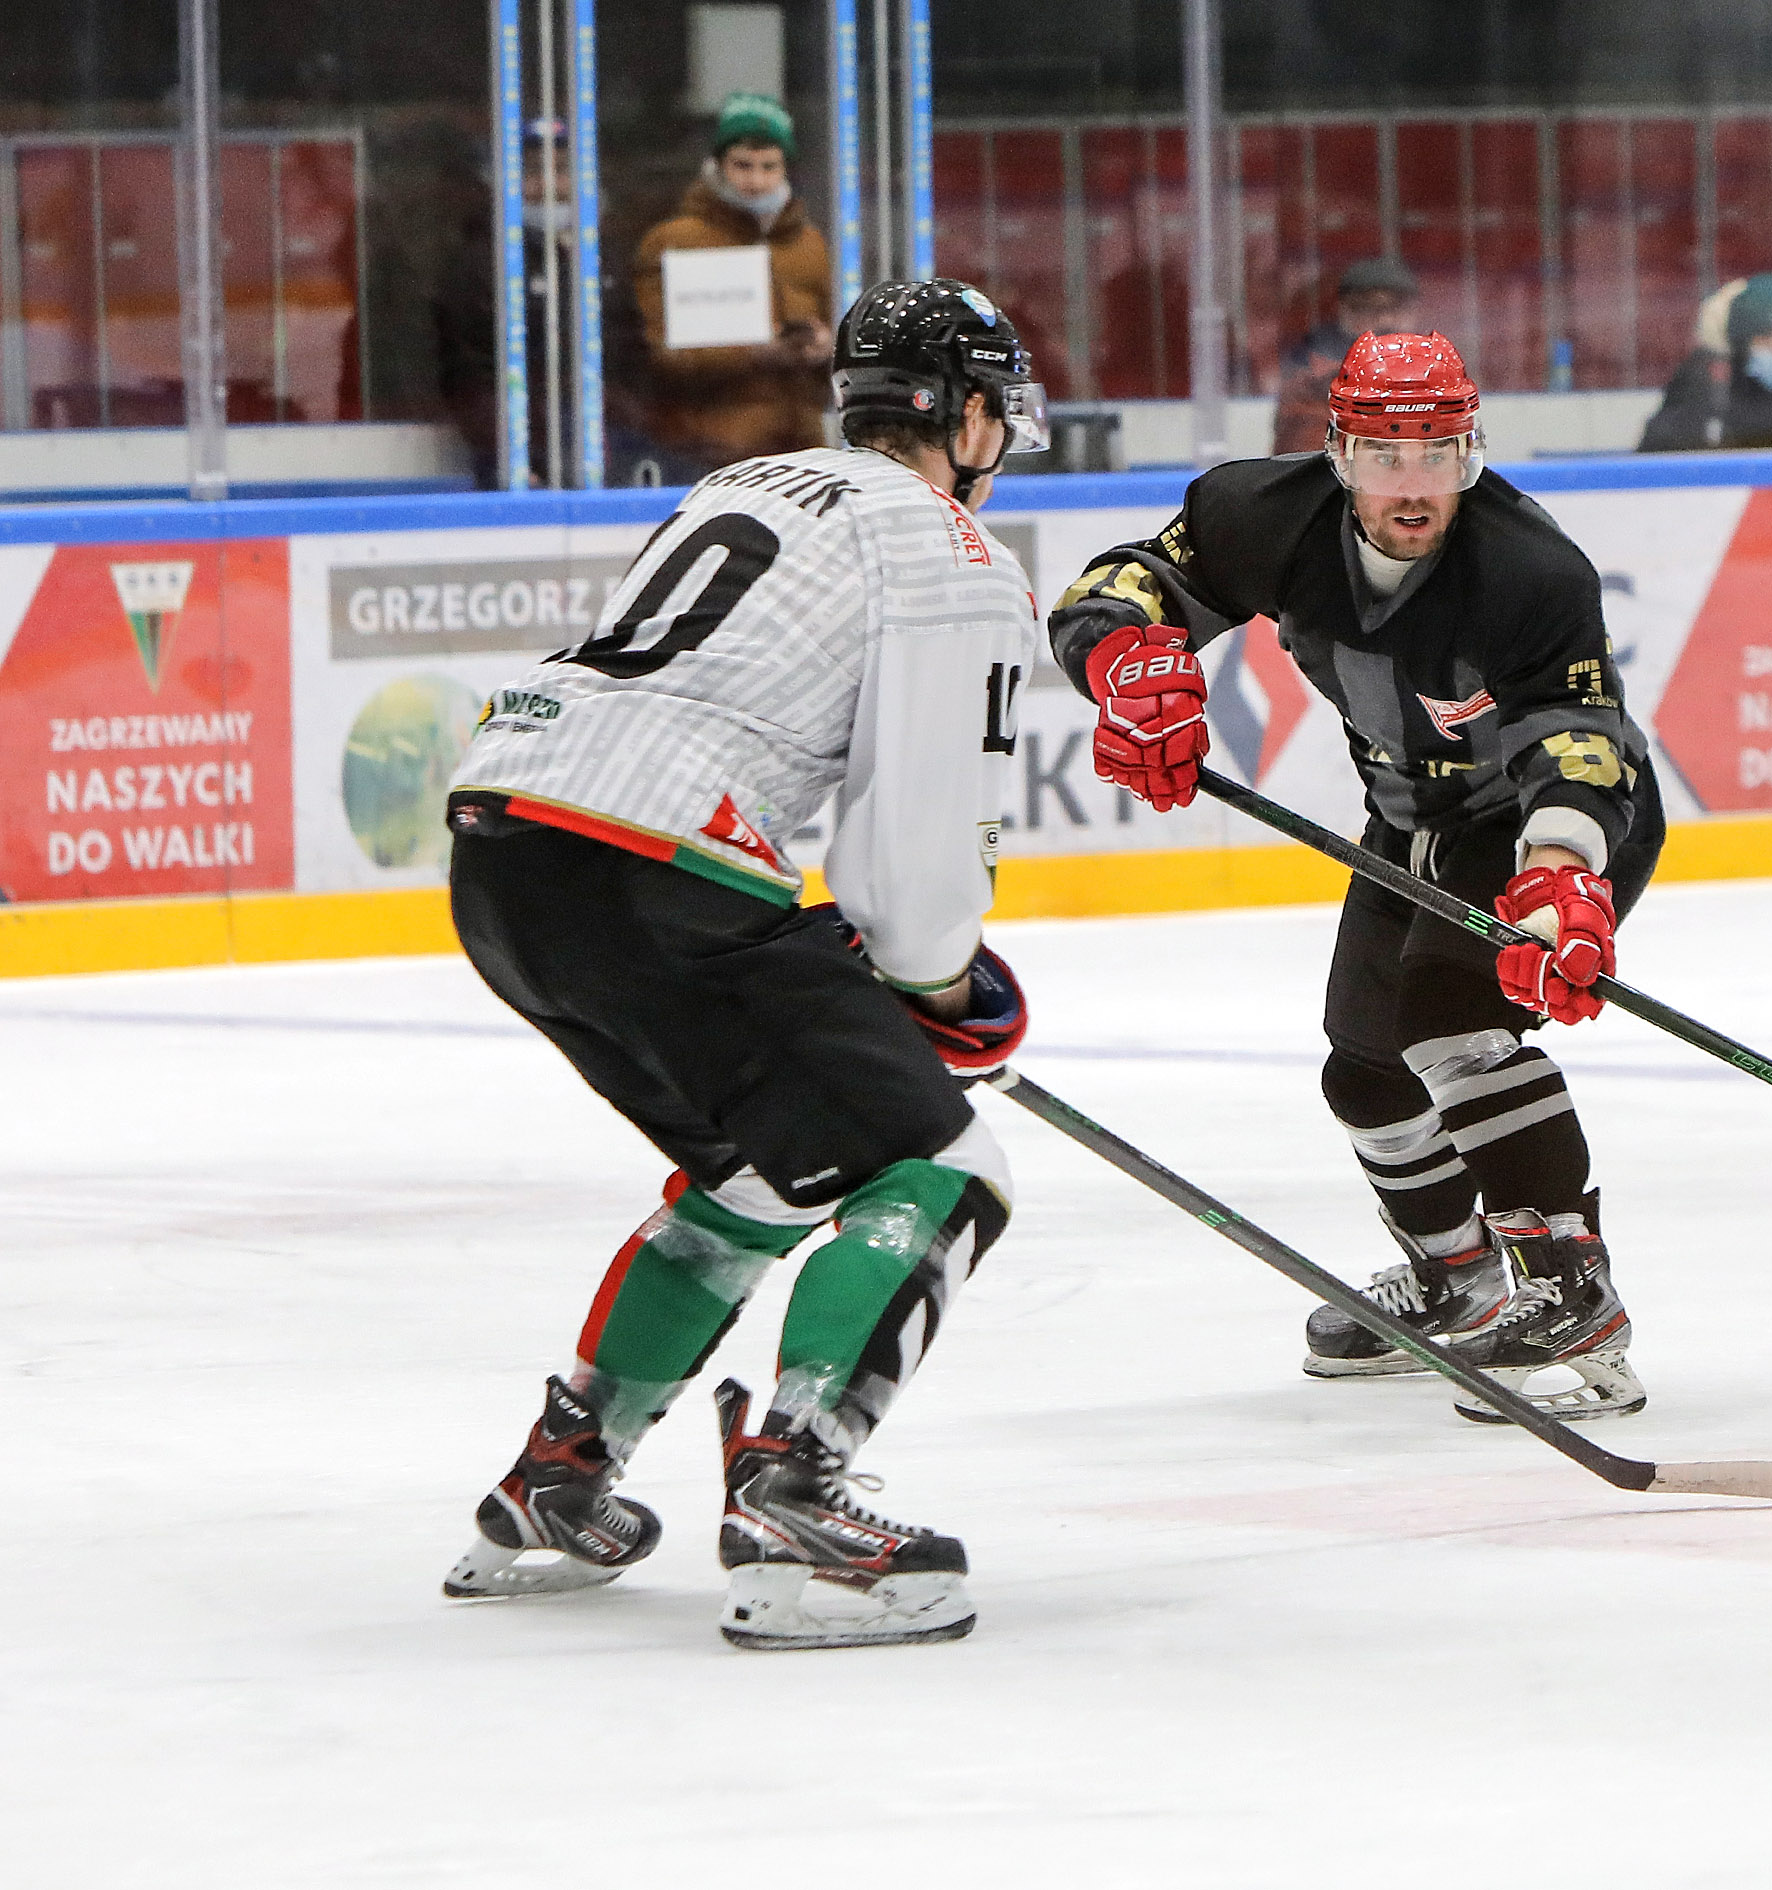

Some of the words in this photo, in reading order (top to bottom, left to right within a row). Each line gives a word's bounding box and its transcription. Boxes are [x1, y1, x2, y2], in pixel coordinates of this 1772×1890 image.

[970, 348, 1008, 362] CCM
[1383, 403, 1437, 413] BAUER
[686, 460, 863, 518] ARTIK
[350, 577, 593, 635] GRZEGORZ
[540, 510, 781, 680] 0
[50, 711, 254, 752] ZAGRZEWAMY
[46, 760, 254, 814] NASZYCH
[48, 828, 113, 877] DO
[121, 821, 255, 872] WALKI
